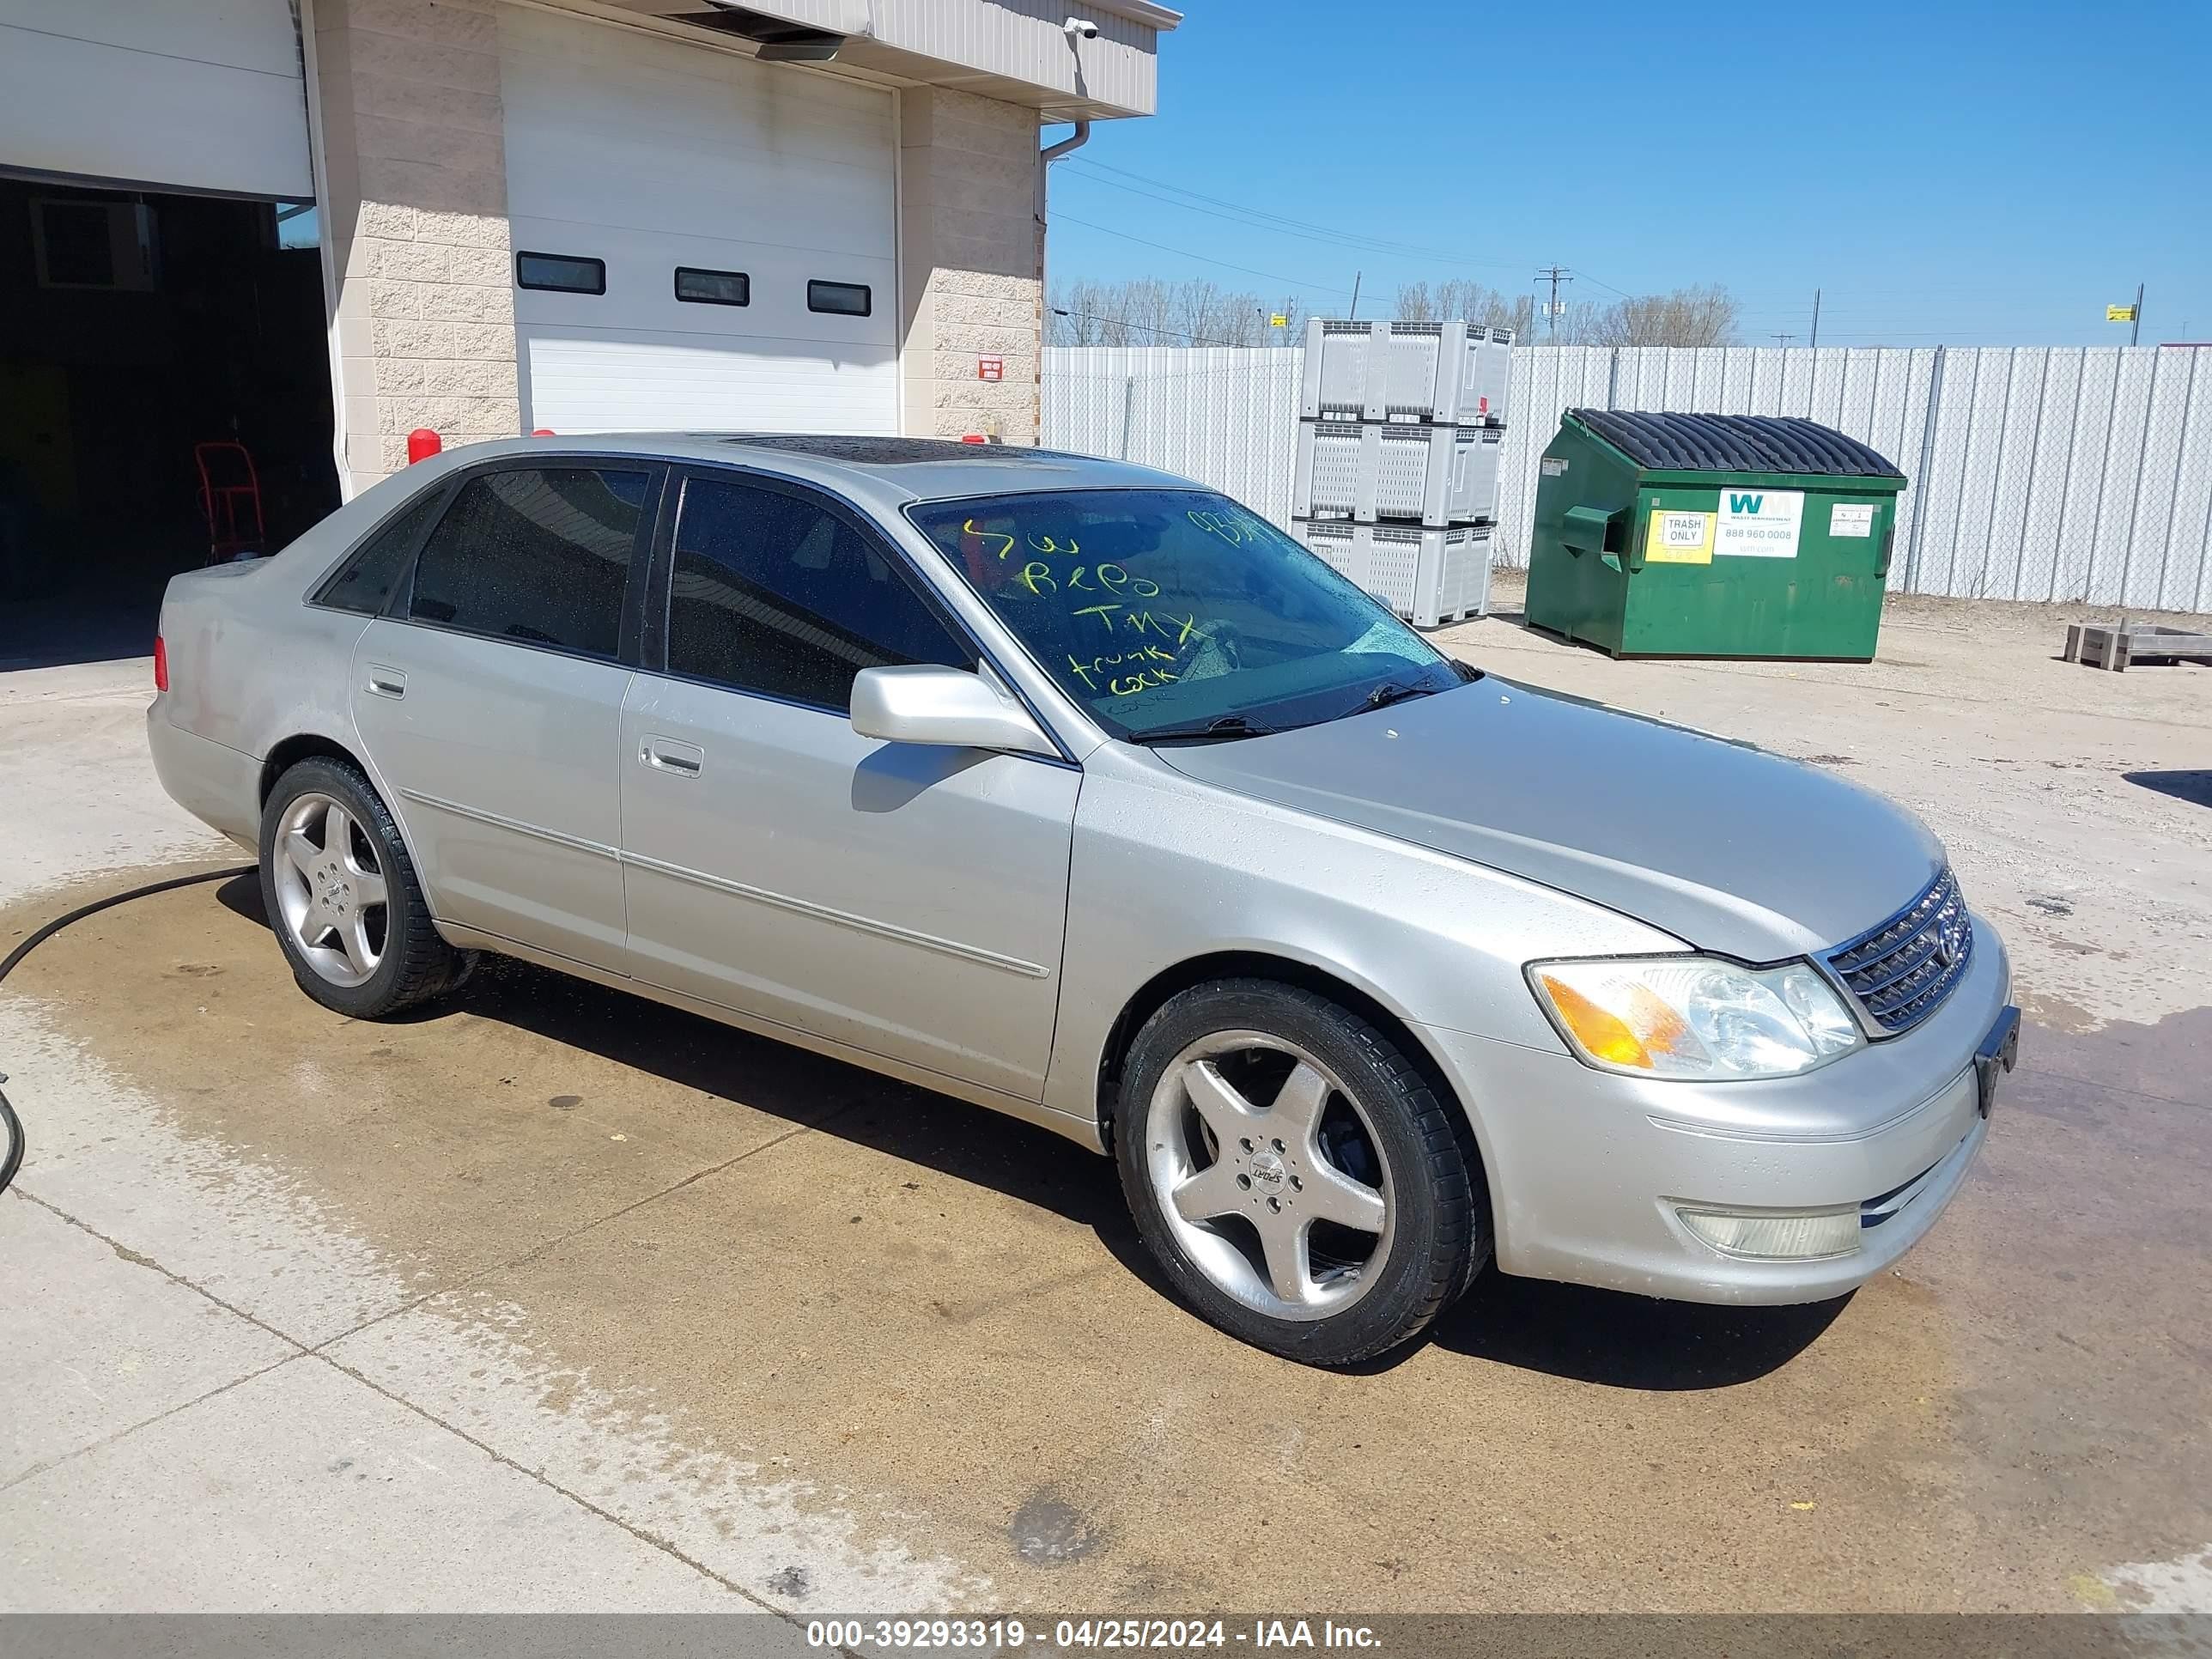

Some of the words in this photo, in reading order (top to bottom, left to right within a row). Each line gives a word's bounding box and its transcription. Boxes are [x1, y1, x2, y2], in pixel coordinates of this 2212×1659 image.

[1668, 519, 1701, 529] TRASH
[1670, 531, 1697, 541] ONLY
[1725, 528, 1744, 538] 888
[1747, 529, 1765, 538] 960
[1767, 530, 1791, 540] 0008
